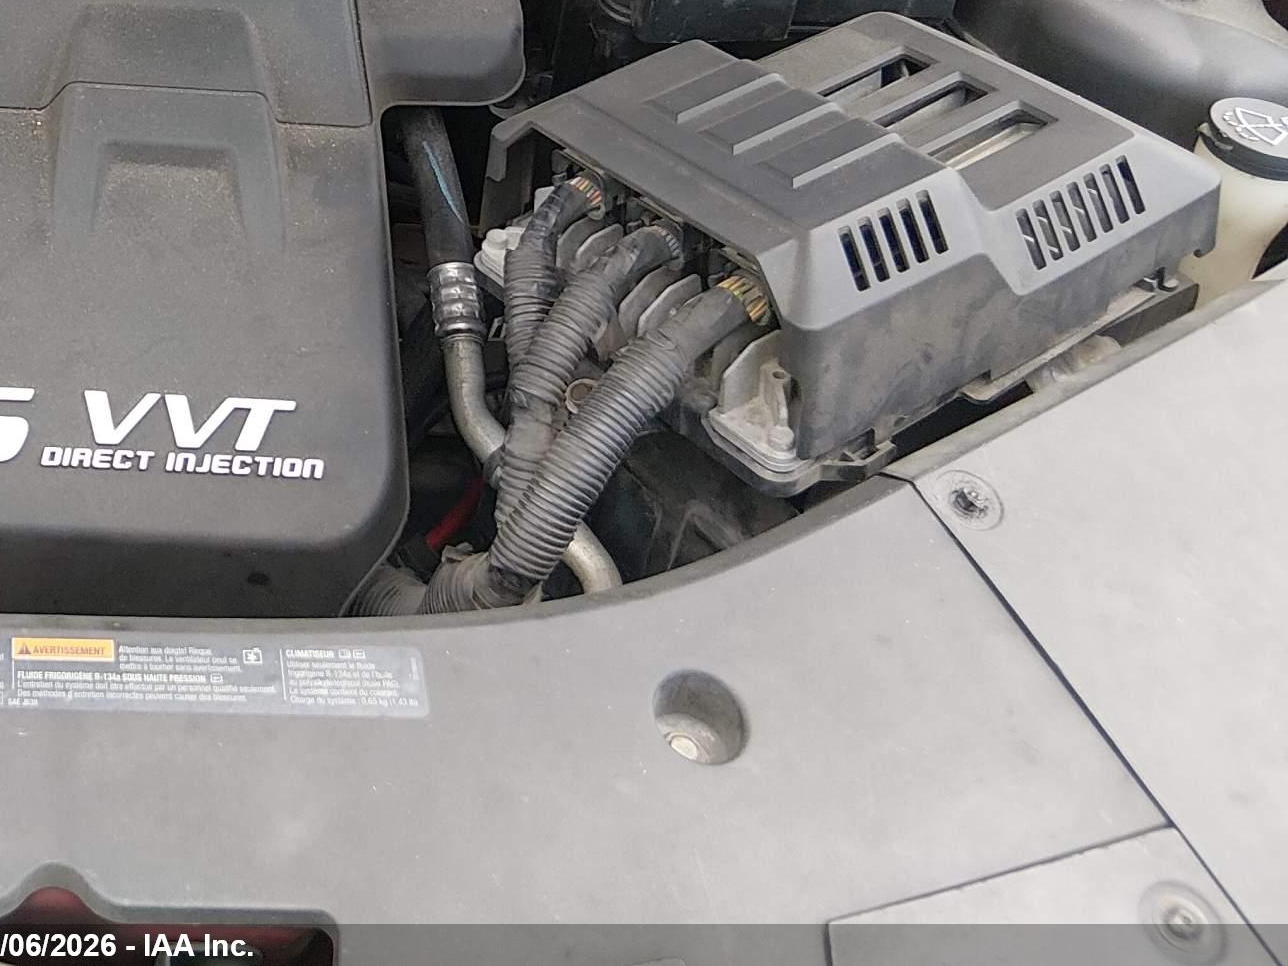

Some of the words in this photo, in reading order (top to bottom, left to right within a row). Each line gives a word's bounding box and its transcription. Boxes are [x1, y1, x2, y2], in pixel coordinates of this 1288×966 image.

[83, 389, 298, 450] VVT
[40, 445, 156, 471] DIRECT
[165, 452, 325, 480] INJECTION
[33, 646, 104, 655] AVERTISSEMENT
[286, 650, 334, 658] CLIMATISEUR
[17, 671, 43, 680] FLUIDE
[144, 674, 168, 682] HAUTE
[170, 674, 206, 683] PRESSION
